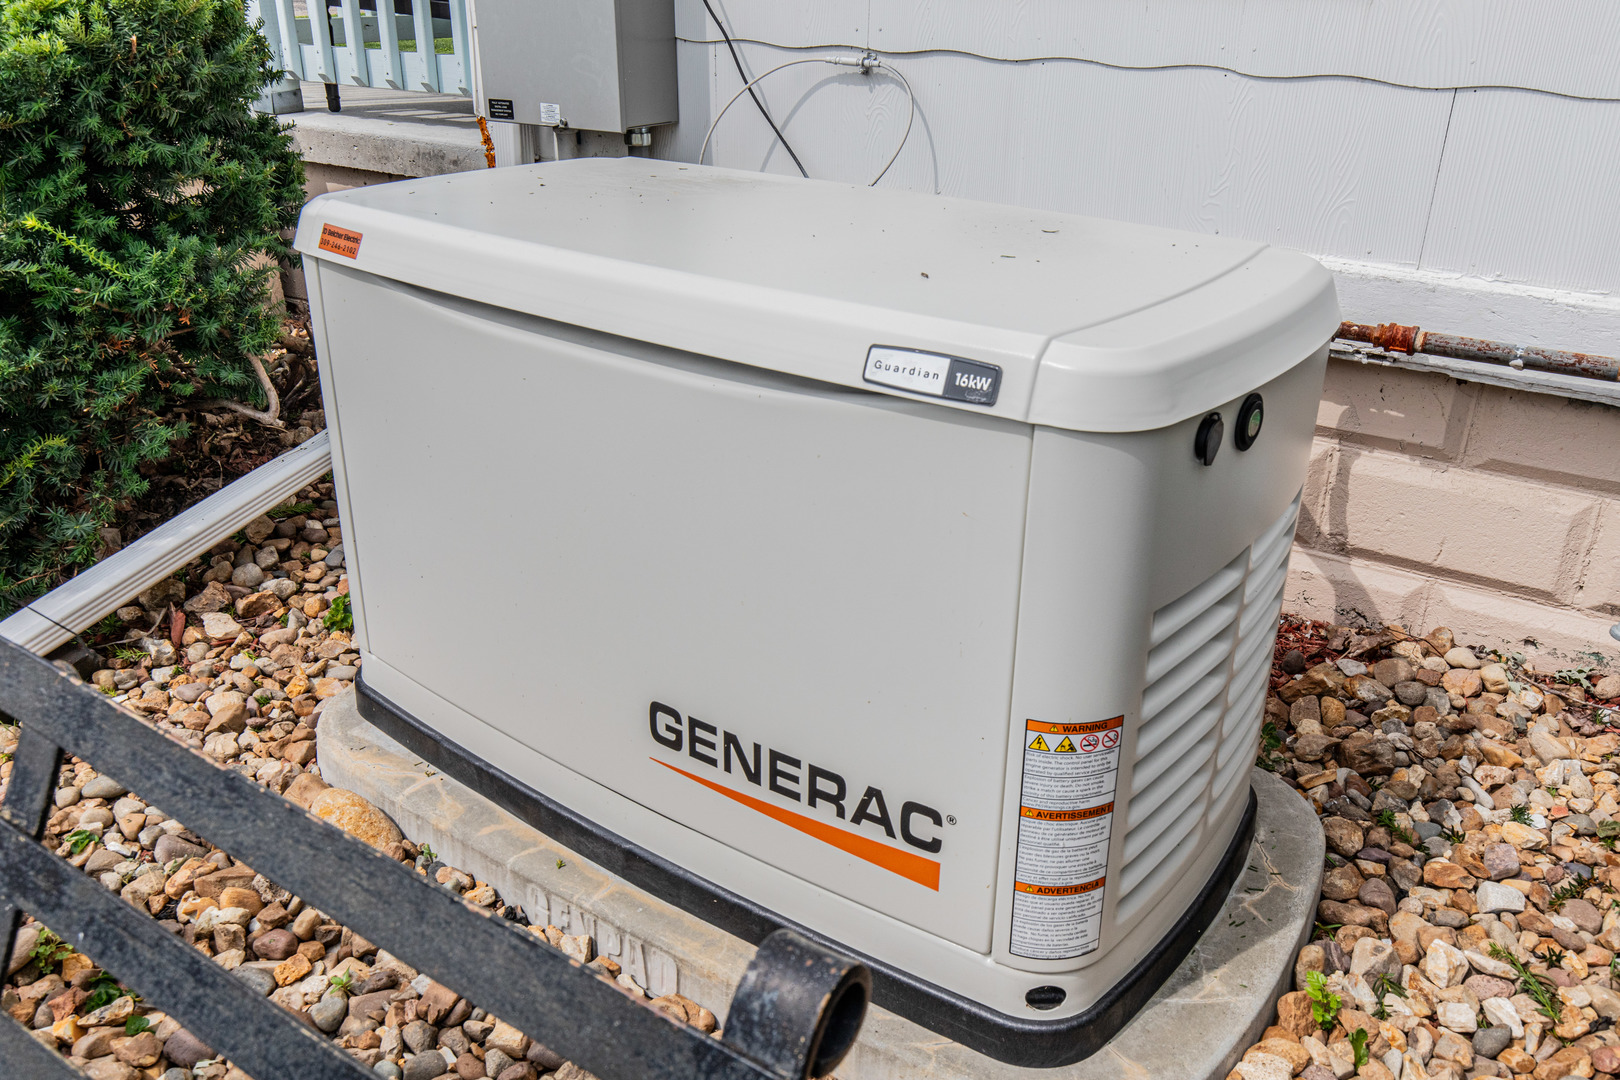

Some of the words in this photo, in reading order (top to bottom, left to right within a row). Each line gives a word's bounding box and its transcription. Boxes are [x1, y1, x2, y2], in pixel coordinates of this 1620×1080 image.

[874, 359, 940, 381] Guardian
[955, 372, 992, 391] 16kW
[1062, 722, 1108, 733] WARNING
[649, 701, 943, 854] GENERAC
[1036, 804, 1112, 820] AVERTISSEMENT
[1036, 881, 1100, 894] ADVERTENCIA
